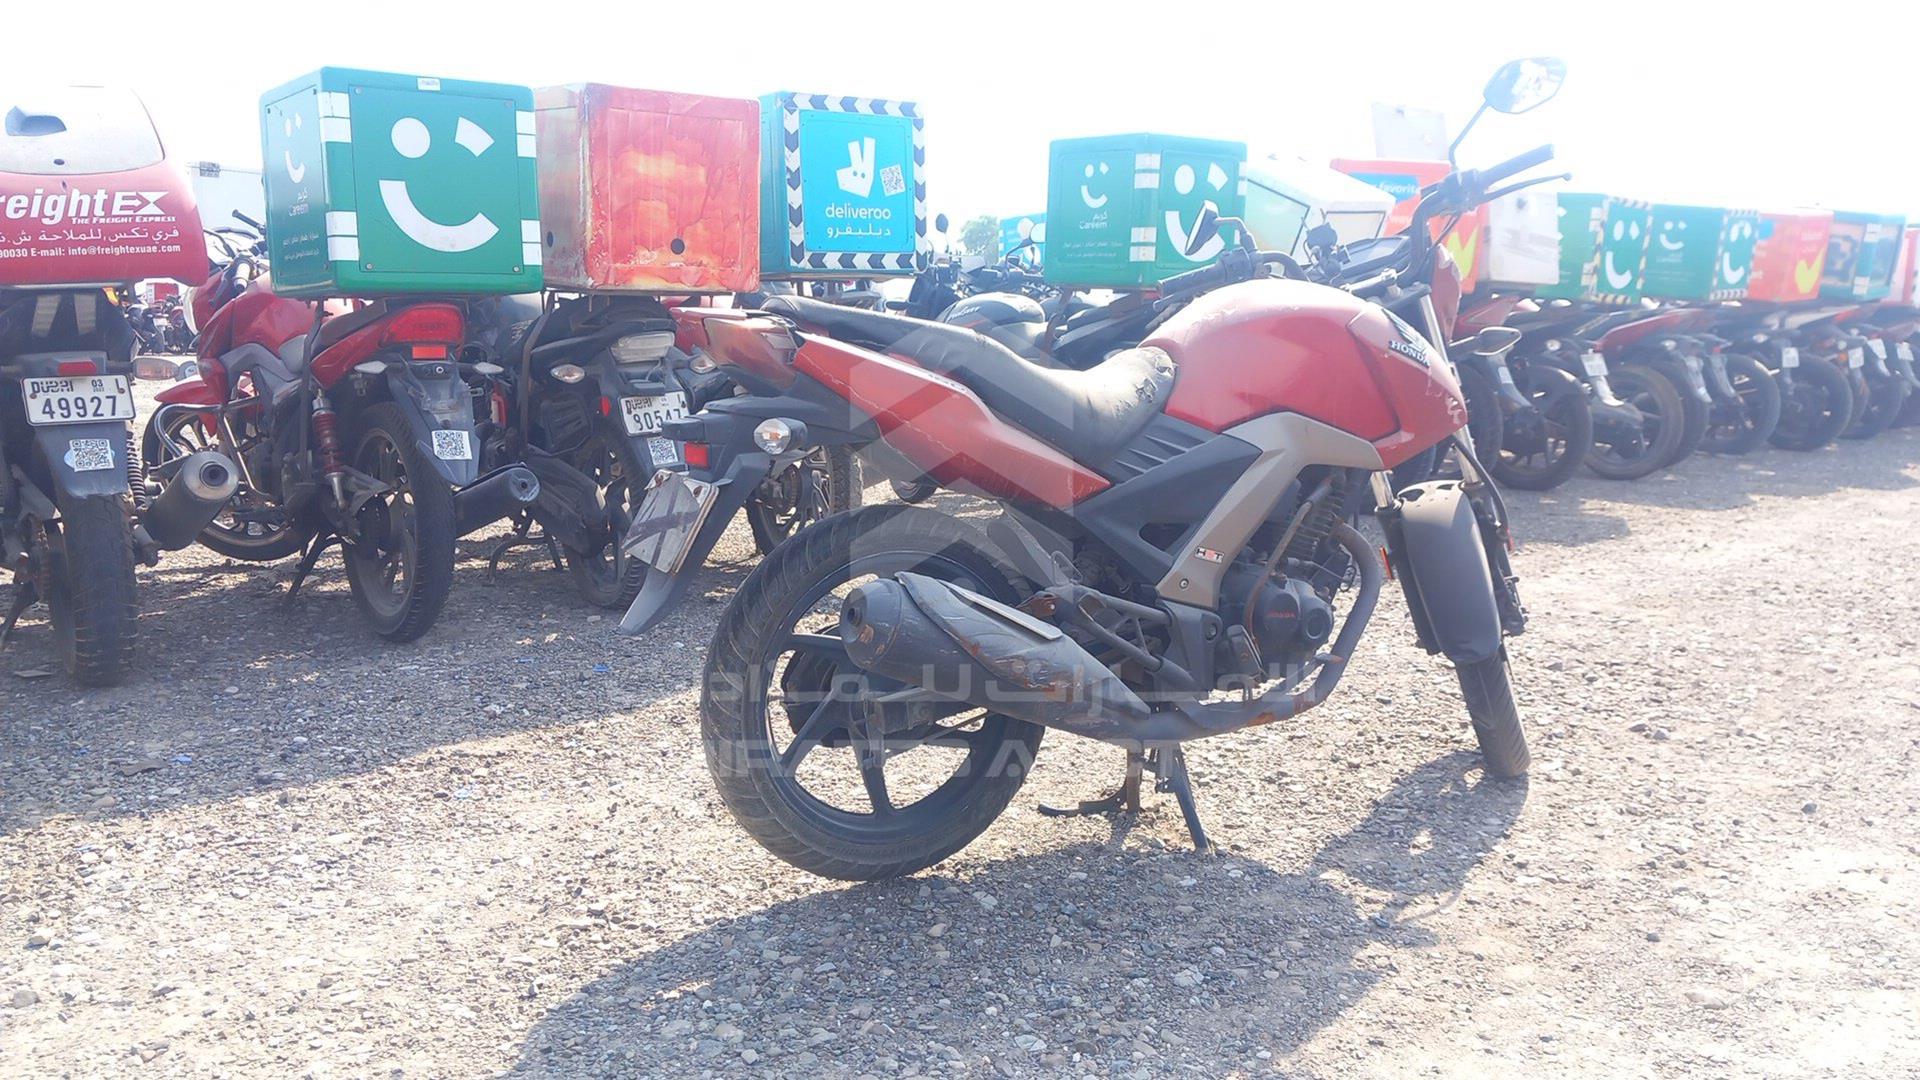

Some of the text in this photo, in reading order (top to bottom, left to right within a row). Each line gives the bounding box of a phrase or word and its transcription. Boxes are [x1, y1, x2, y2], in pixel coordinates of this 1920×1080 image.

[825, 202, 892, 220] deliveroo
[71, 215, 176, 225] THE FREIGHT EXPRESS
[826, 222, 892, 239] ديليفرو
[30, 247, 66, 258] E-mail:
[68, 245, 182, 257] info@freightexuae.com
[1390, 340, 1431, 367] HONDA
[30, 380, 75, 395] DUBAI
[41, 395, 118, 420] 49927
